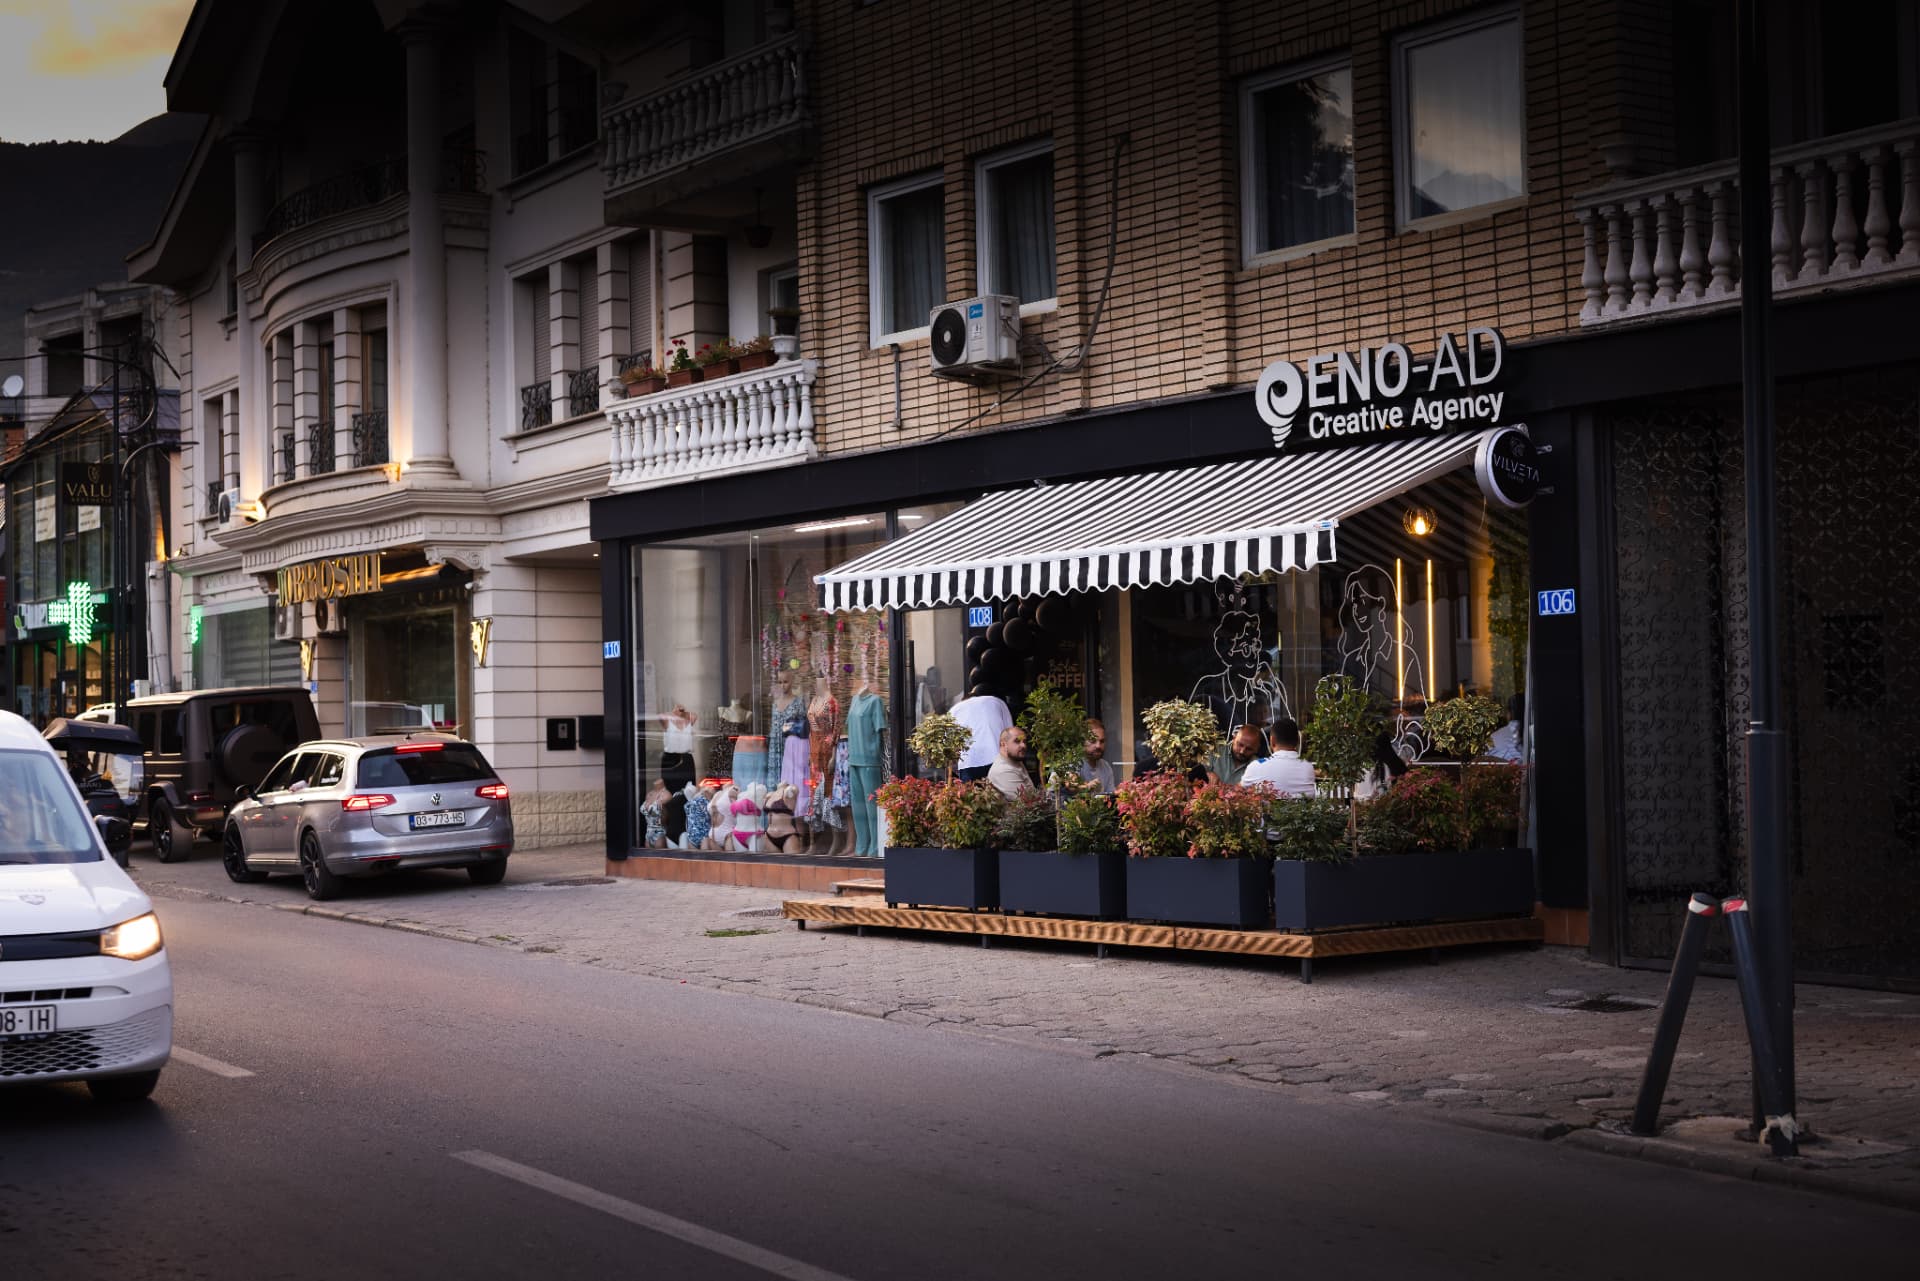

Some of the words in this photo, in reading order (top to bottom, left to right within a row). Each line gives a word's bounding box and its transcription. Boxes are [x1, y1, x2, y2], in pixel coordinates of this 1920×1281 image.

[1308, 403, 1404, 439] Creative
[1410, 391, 1505, 430] Agency
[66, 482, 112, 498] VALU
[1540, 591, 1573, 614] 106
[970, 607, 991, 626] 108
